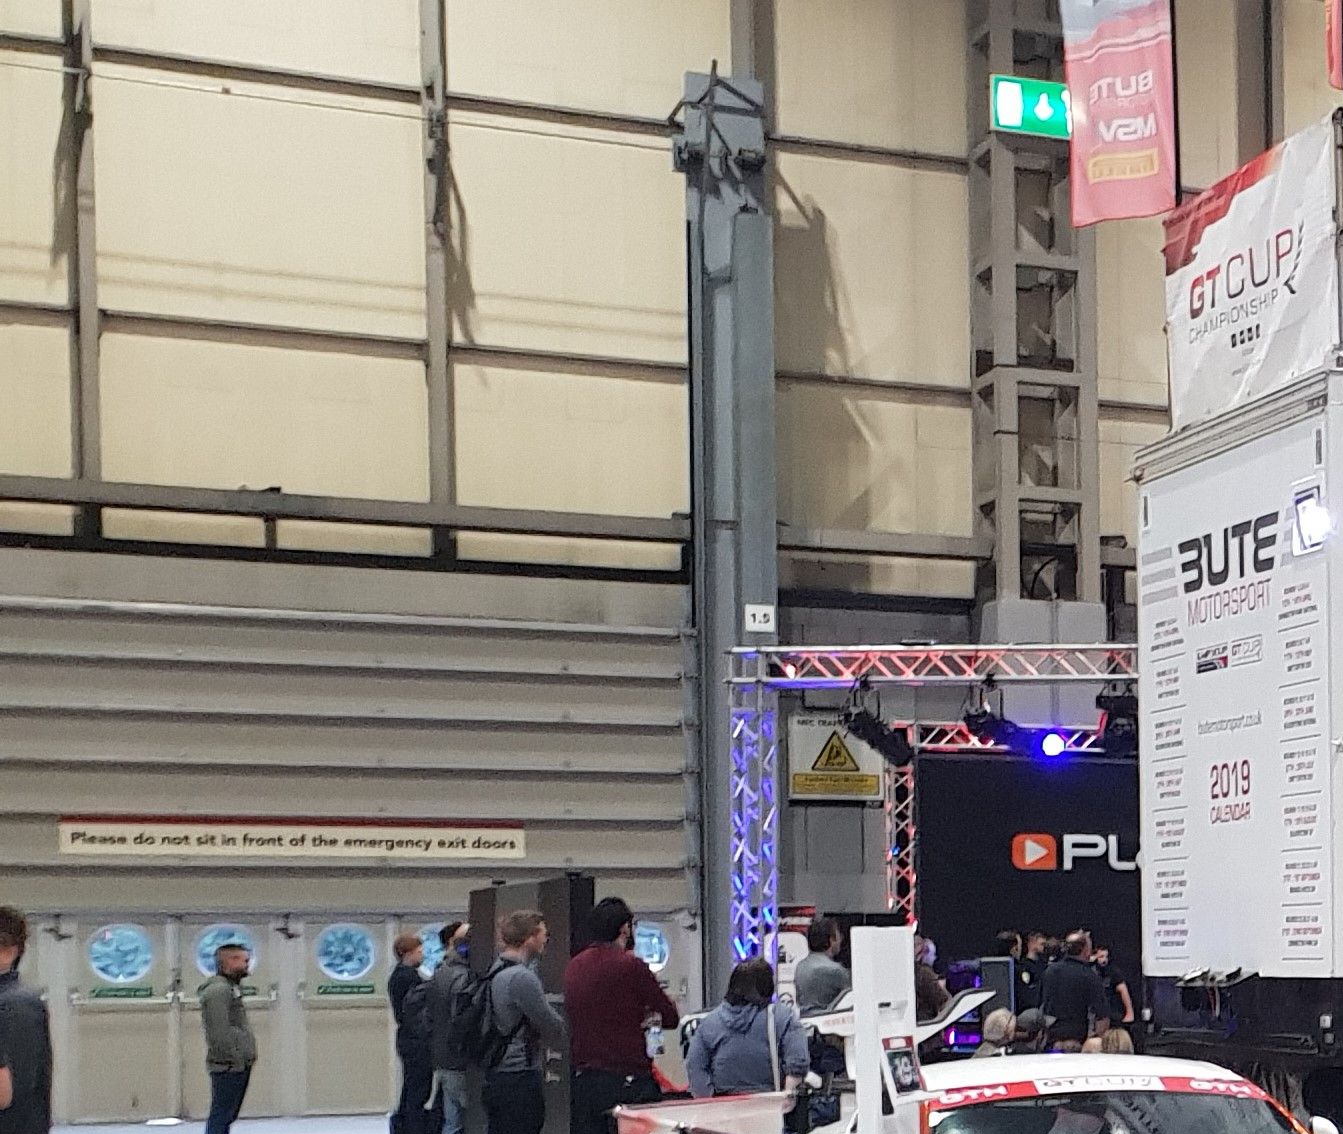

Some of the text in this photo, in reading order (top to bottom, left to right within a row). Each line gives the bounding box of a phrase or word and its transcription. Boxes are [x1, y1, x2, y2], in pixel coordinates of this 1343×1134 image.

[1190, 229, 1293, 320] GT CUP
[1178, 511, 1280, 595] BUTE
[1187, 577, 1273, 627] MOTORSPORT
[1210, 759, 1251, 800] 2019
[1210, 801, 1251, 825] CALENDAR
[70, 831, 517, 851] Please do not sit in front of the emergency exit doors
